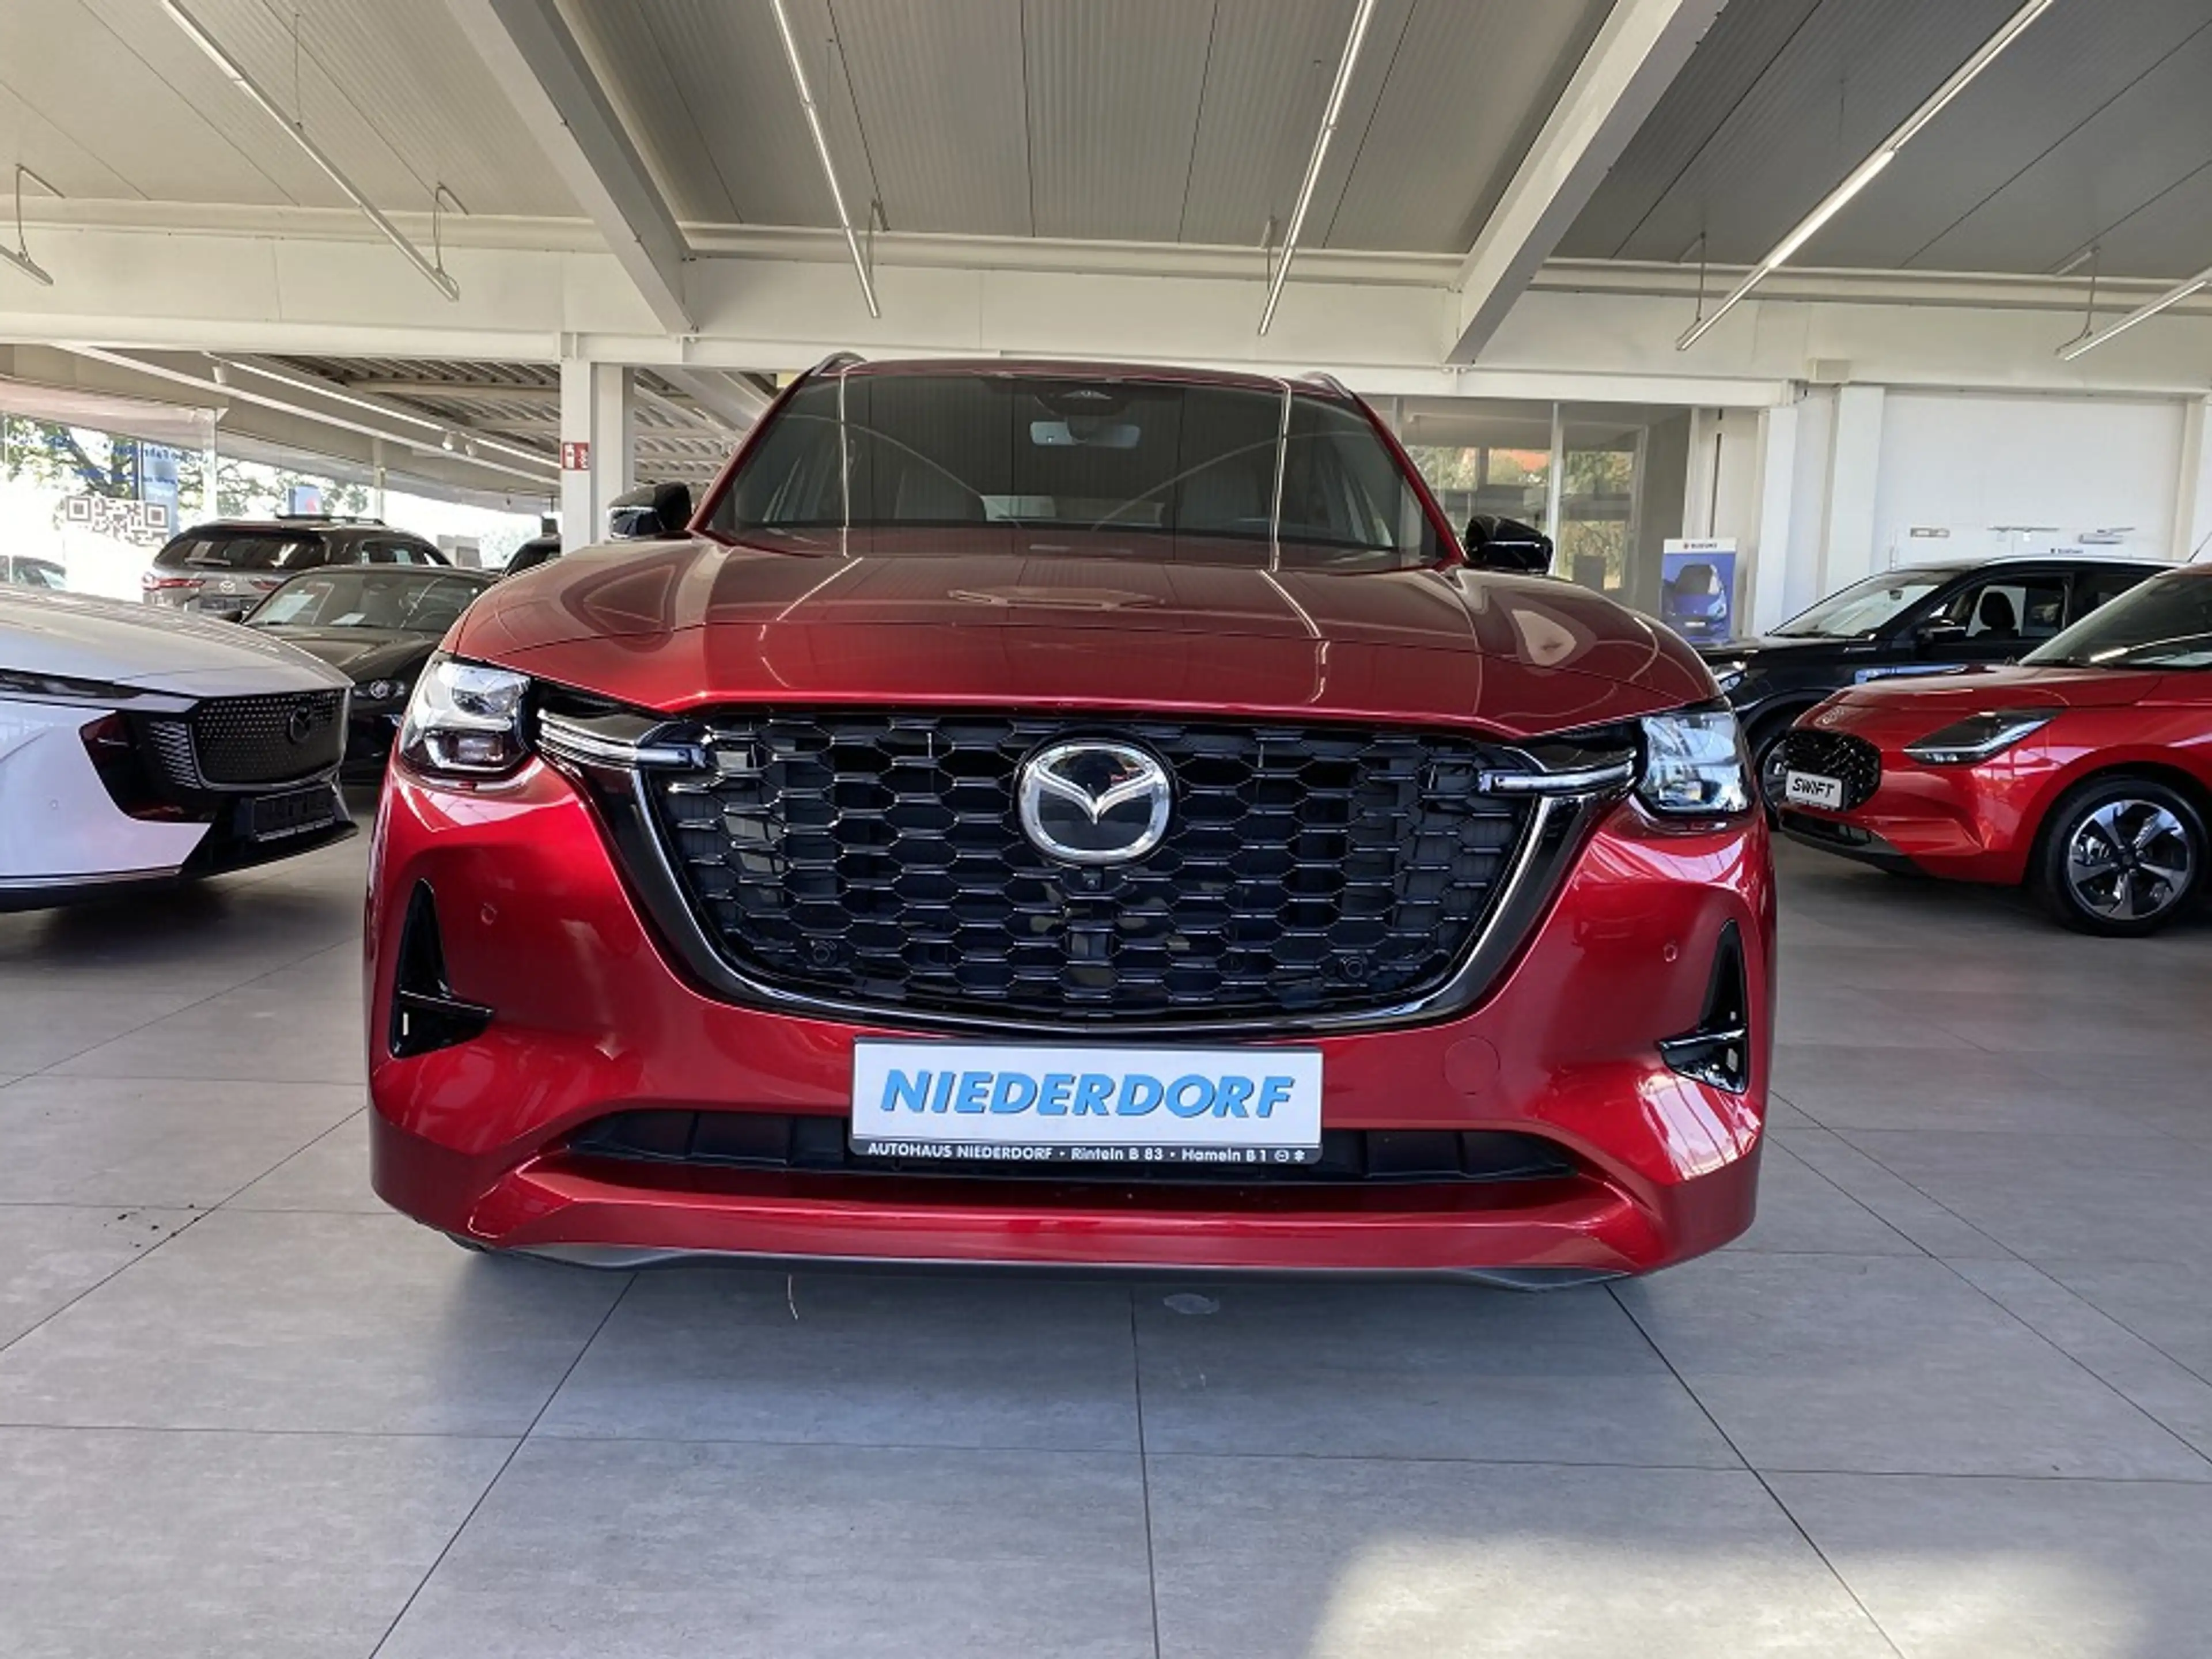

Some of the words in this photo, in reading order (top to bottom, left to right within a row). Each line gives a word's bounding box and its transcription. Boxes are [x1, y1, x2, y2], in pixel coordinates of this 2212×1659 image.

[1792, 777, 1835, 798] SWIFT
[880, 1069, 1295, 1118] NIEDERDORF
[868, 1142, 952, 1158] AUTOHAUS
[956, 1145, 1053, 1160] NIEDERDORF
[1071, 1147, 1123, 1160] Rinteln
[1128, 1148, 1140, 1161] B
[1144, 1147, 1163, 1161] 83
[1181, 1147, 1241, 1162] Hameln
